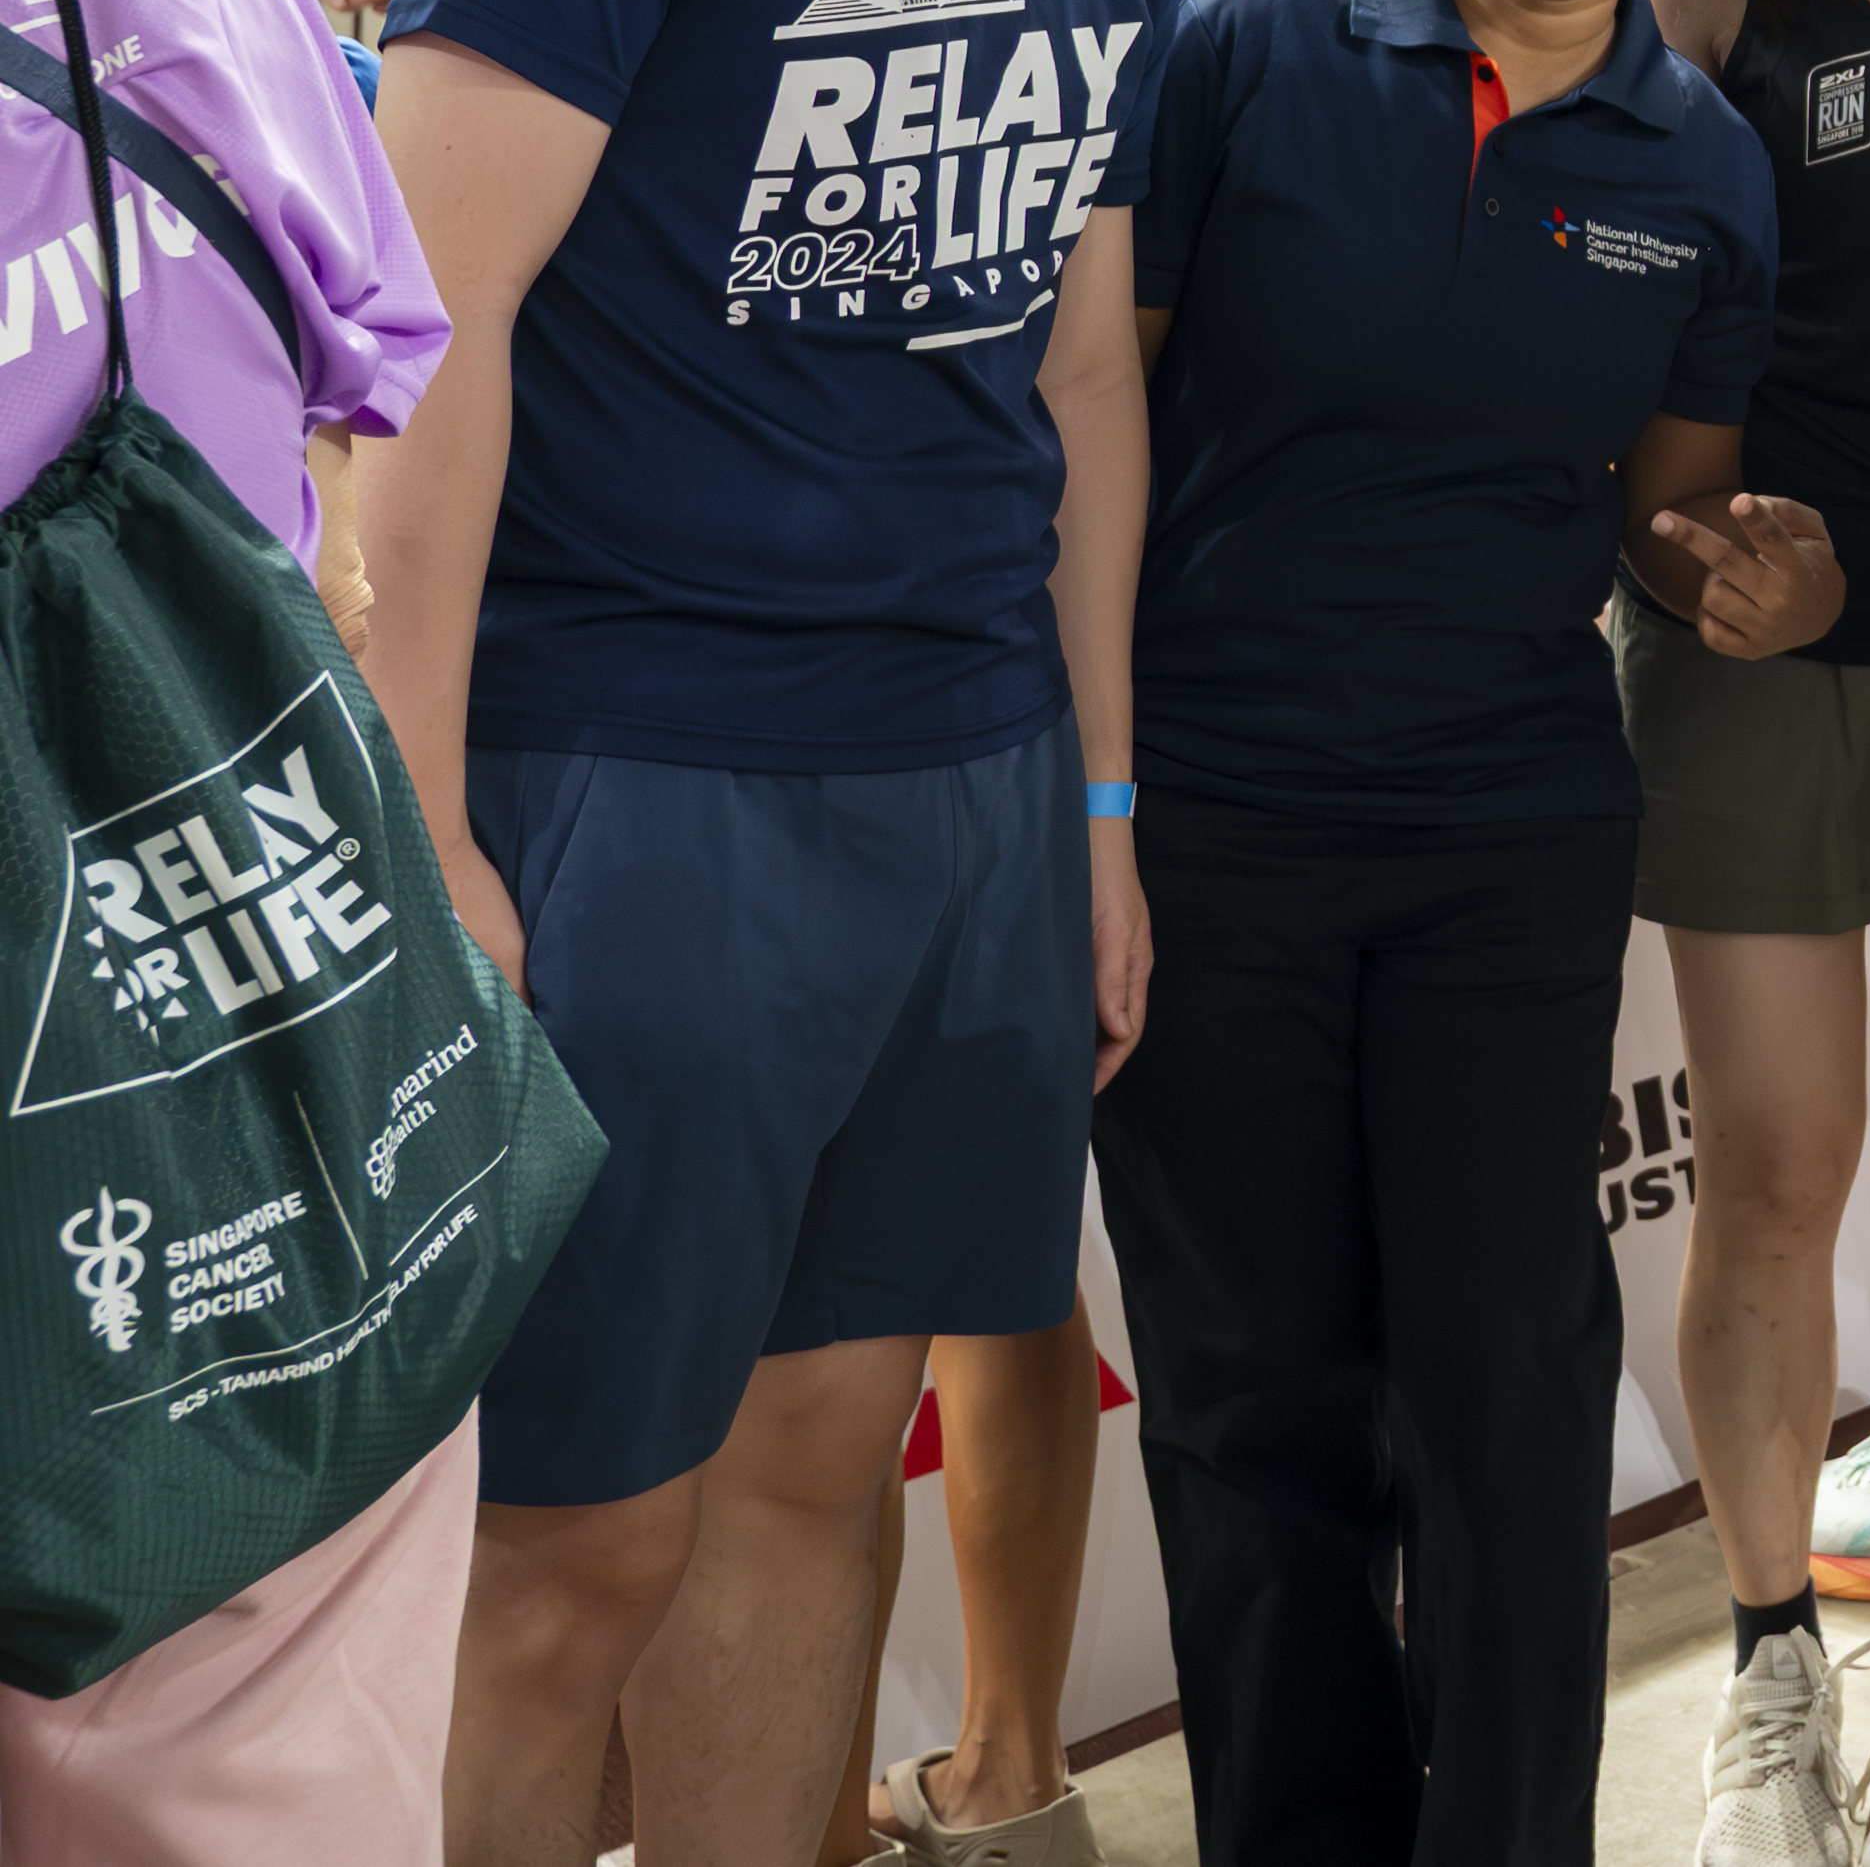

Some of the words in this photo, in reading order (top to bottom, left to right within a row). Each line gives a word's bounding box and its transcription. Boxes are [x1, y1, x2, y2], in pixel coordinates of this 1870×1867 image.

[754, 21, 1144, 172] RELAY
[1820, 65, 1866, 89] 2XU
[1819, 91, 1865, 132] RUN
[738, 164, 922, 232] FOR
[931, 129, 1117, 269] LIFE
[726, 223, 921, 294] 2024
[1586, 219, 1638, 243] National
[1640, 233, 1698, 260] University
[1586, 235, 1629, 255] Cancer
[1631, 244, 1679, 268] Institute
[1586, 248, 1647, 274] Singapore
[82, 744, 340, 943] RELAY
[165, 1190, 307, 1268] SINGAPORE
[168, 1243, 275, 1299] CANCER
[170, 1271, 286, 1333] SOCIETY
[218, 1351, 334, 1394] TAMARIND
[420, 1235, 449, 1270] FOR
[444, 1203, 479, 1245] LIFE
